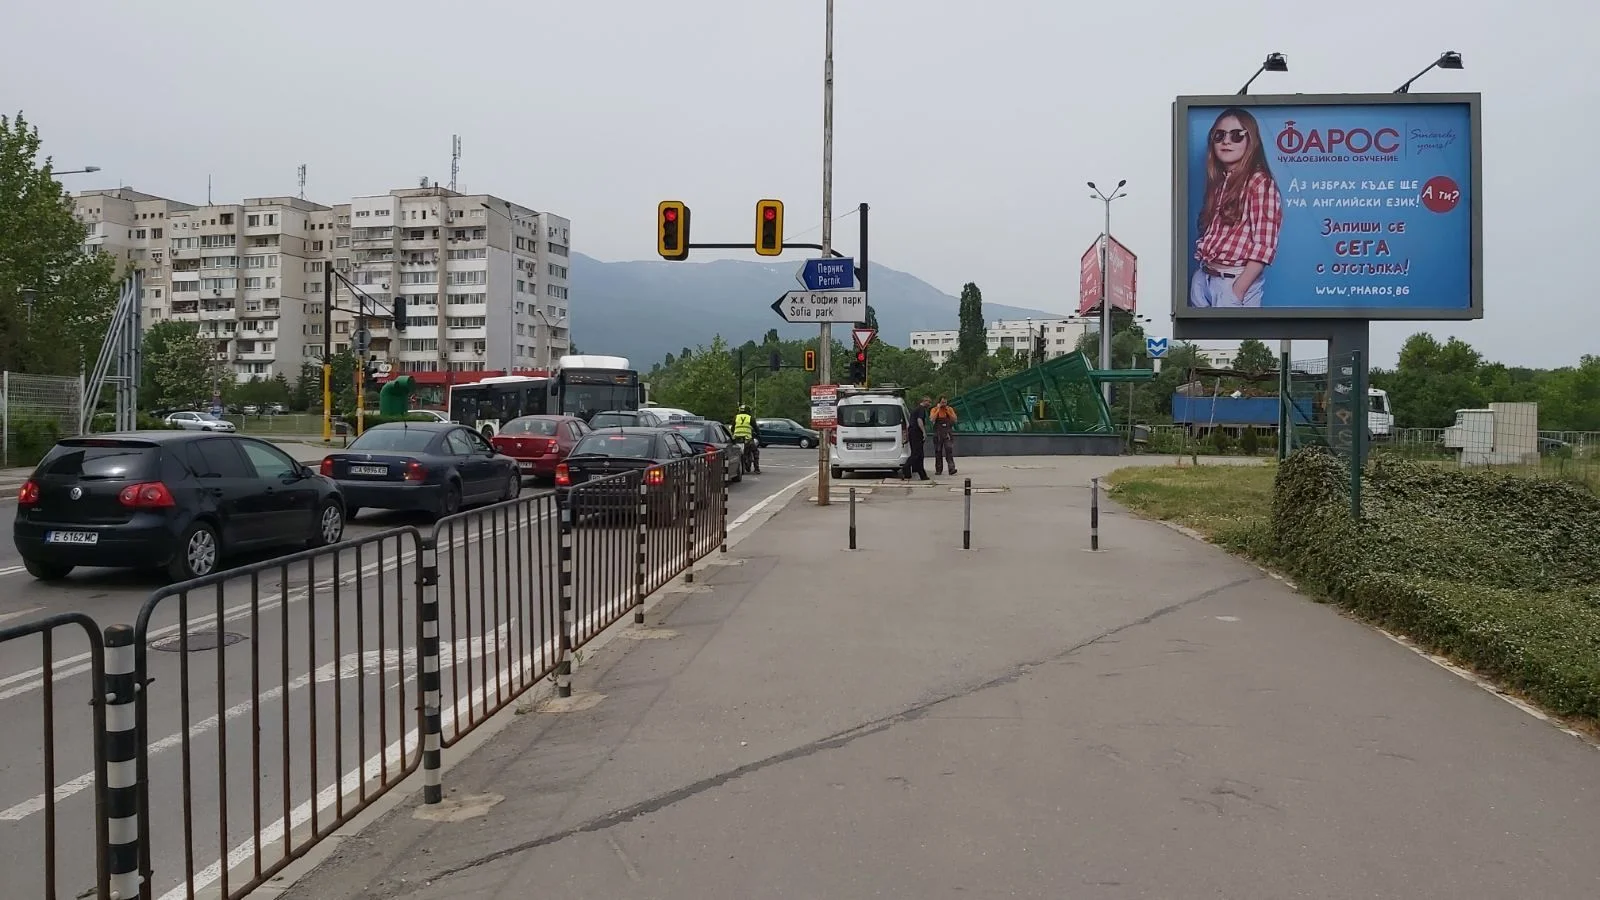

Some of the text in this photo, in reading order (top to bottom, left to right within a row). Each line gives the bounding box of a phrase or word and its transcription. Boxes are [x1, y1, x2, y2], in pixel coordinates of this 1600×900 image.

[1277, 125, 1400, 154] ФАРОС
[1410, 128, 1456, 144] Sincerely
[1278, 155, 1350, 163] ЧУЖДОЕЗИКОВО
[1312, 180, 1356, 190] ИЗБРАХ
[1361, 180, 1394, 190] КЪДЕ
[1400, 180, 1419, 191] ЩЕ
[1422, 186, 1433, 199] А
[1286, 194, 1420, 208] УЧА АНГЛИЙСКИ ЕЗИК!
[1388, 221, 1406, 234] СЕ
[1335, 239, 1391, 257] СЕГА
[817, 263, 844, 275] Перник
[1331, 259, 1410, 276] ОТСТЪПКА!
[818, 276, 841, 286] Pernik
[1315, 286, 1410, 297] WWW.PHAROS.BG
[790, 294, 862, 306] ж.к София парк
[790, 306, 834, 318] Sofia park
[54, 532, 97, 543] E 6162 MC
